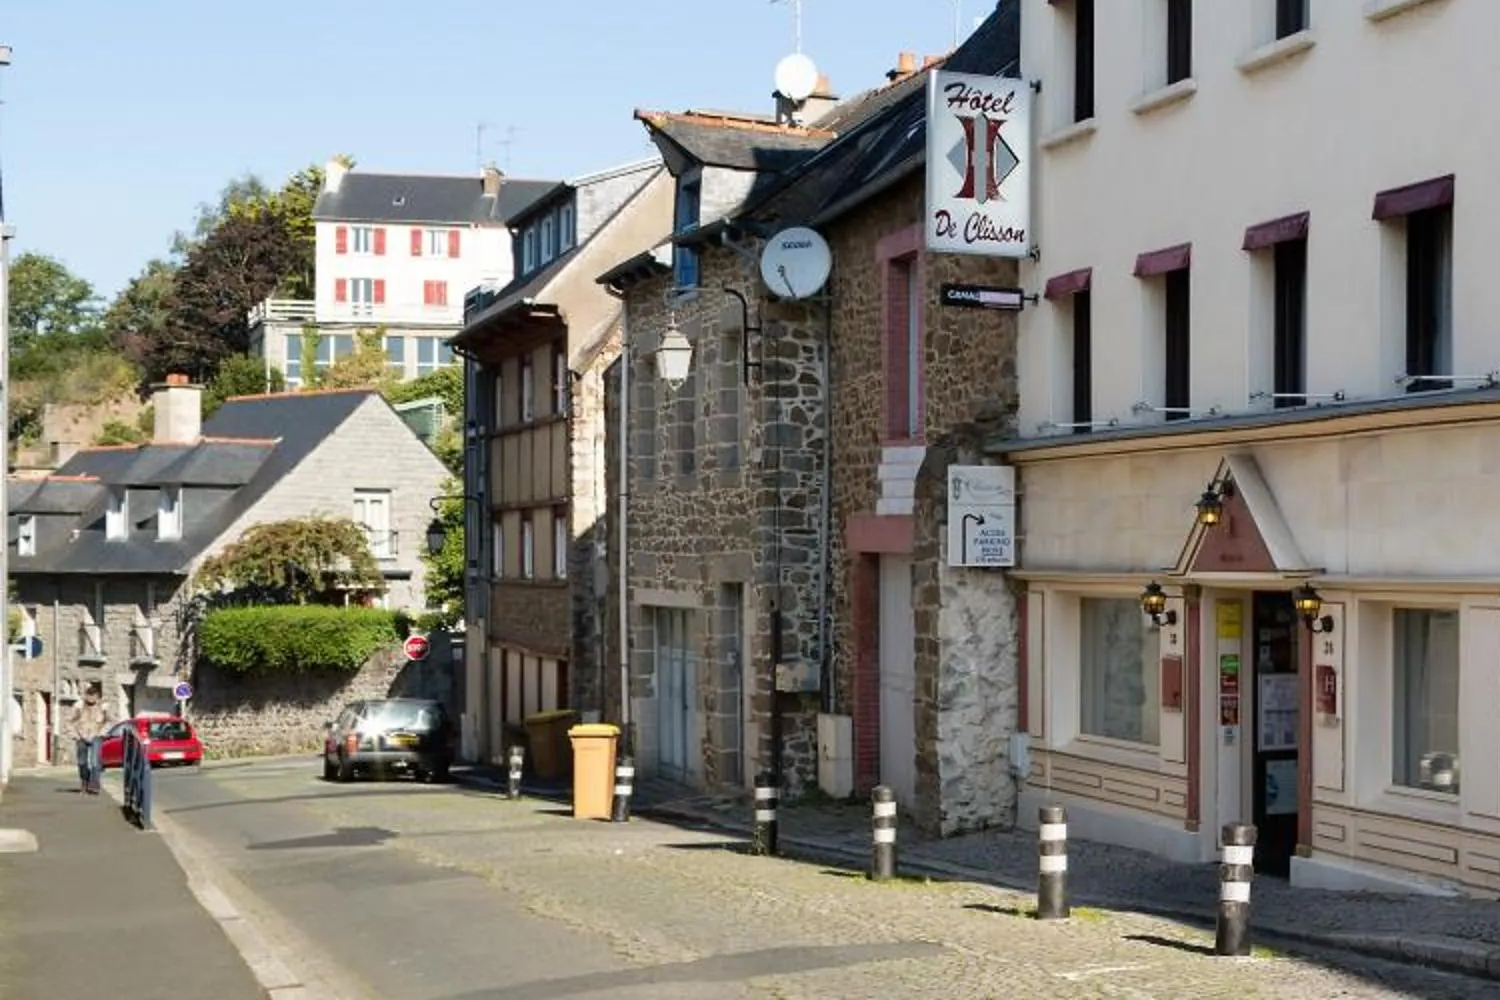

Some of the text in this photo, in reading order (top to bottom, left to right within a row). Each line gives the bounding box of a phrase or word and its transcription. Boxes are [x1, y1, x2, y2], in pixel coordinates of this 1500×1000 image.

[943, 81, 1015, 114] Hôtel
[935, 209, 1025, 244] De Clisson
